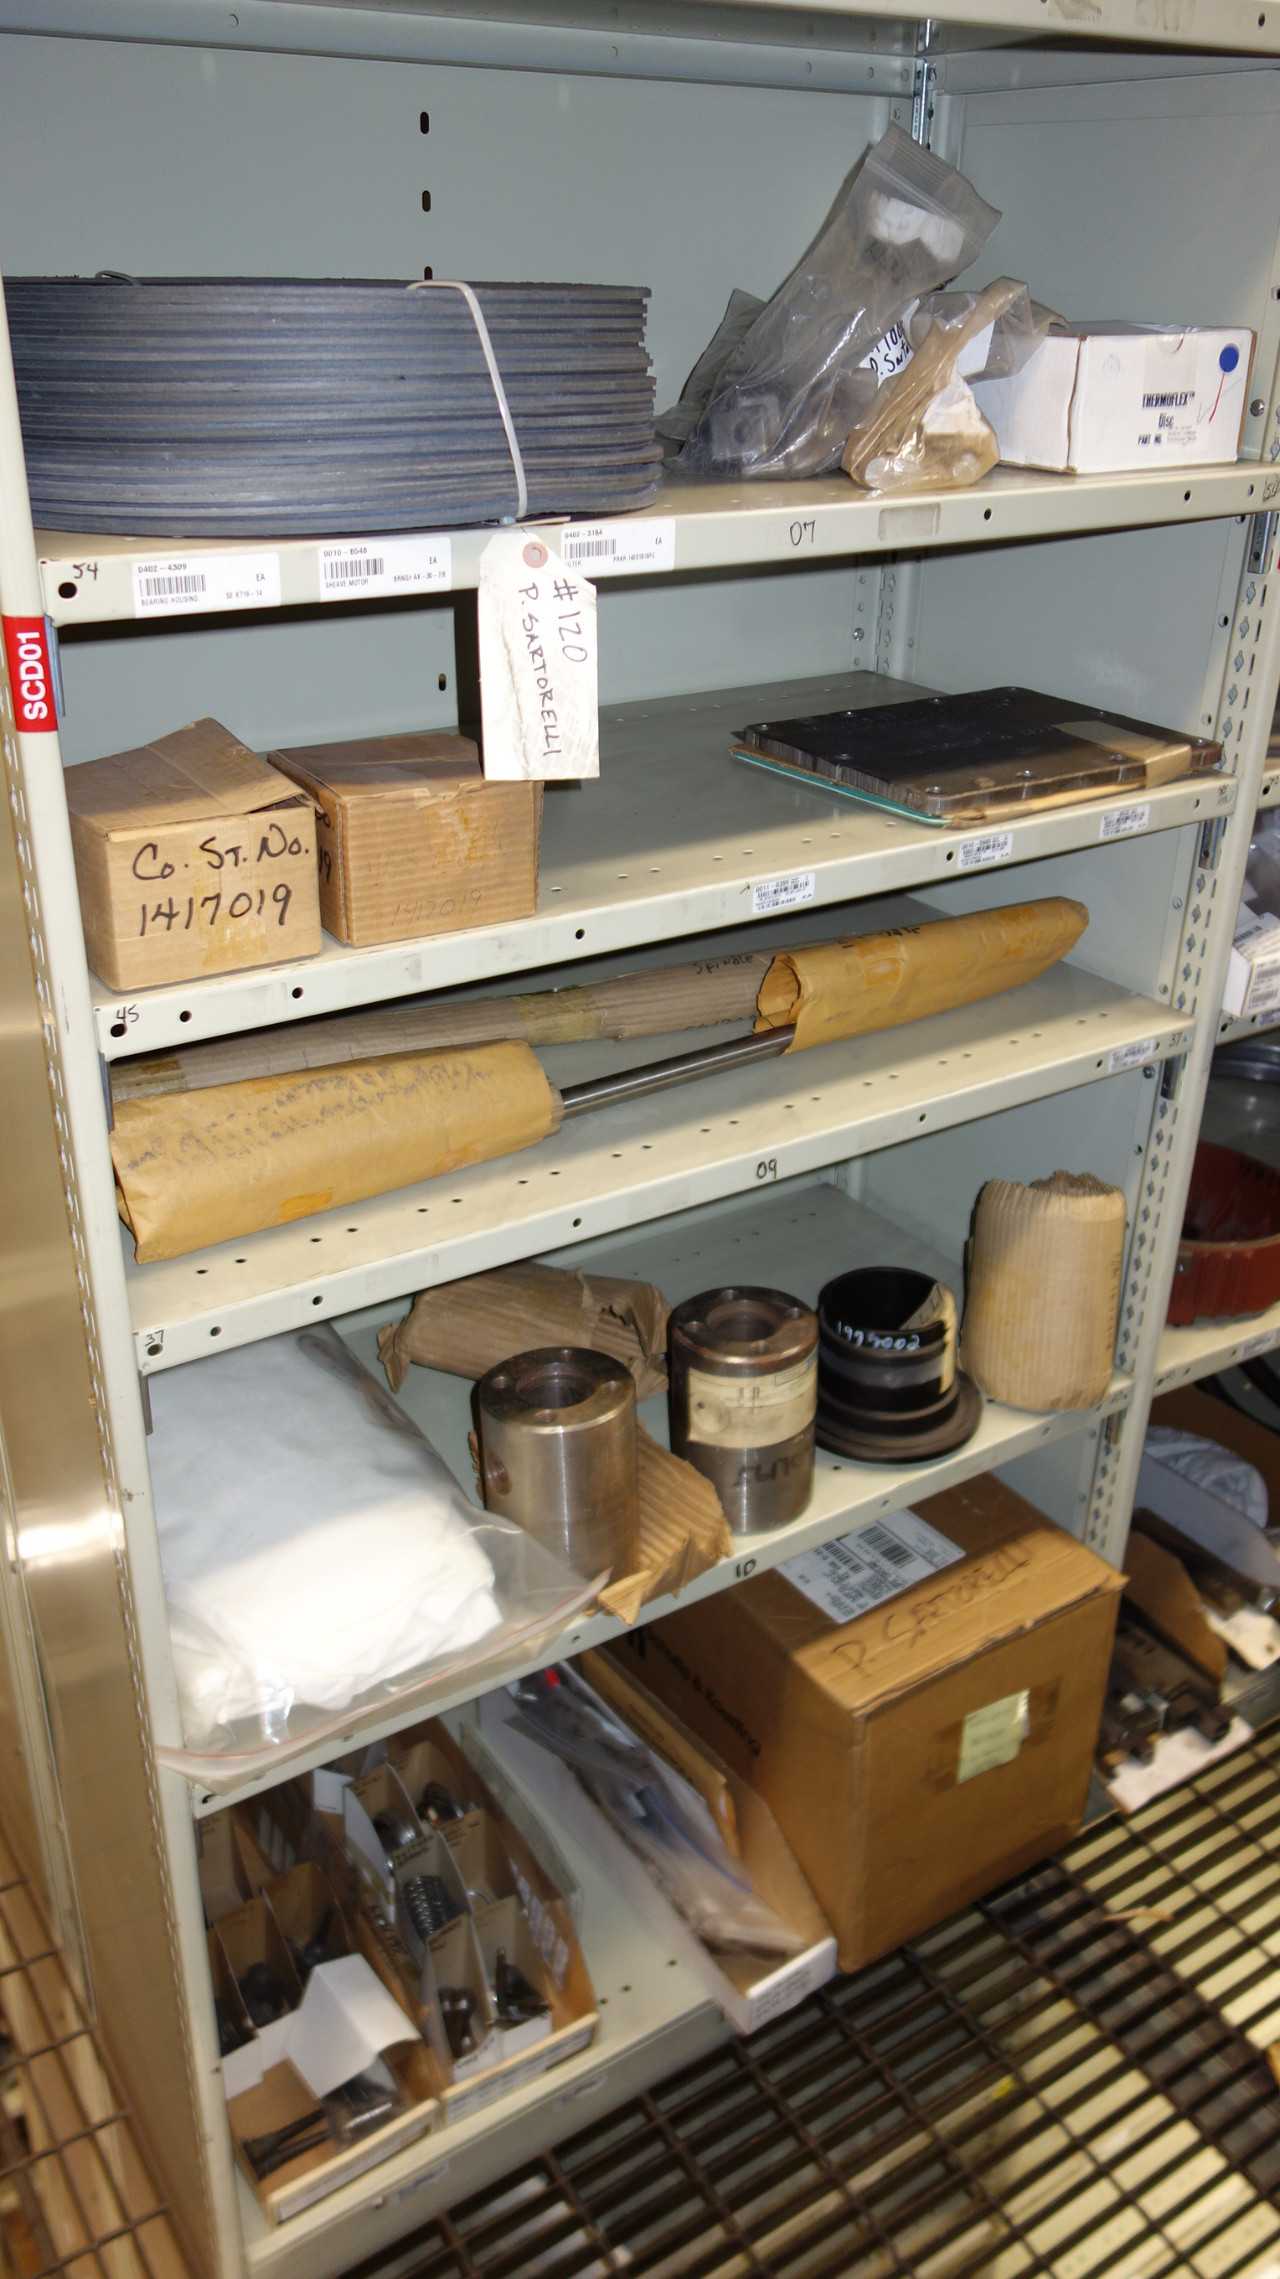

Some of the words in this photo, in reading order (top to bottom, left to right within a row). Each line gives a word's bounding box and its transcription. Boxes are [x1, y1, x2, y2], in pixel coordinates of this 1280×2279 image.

[789, 520, 816, 546] 07
[72, 562, 98, 580] 54
[16, 631, 48, 720] SCD01
[523, 613, 563, 756] SARTORELLI
[138, 884, 293, 936] 1417019
[116, 1004, 140, 1023] 45
[756, 1159, 777, 1179] 09
[144, 1330, 164, 1347] 37
